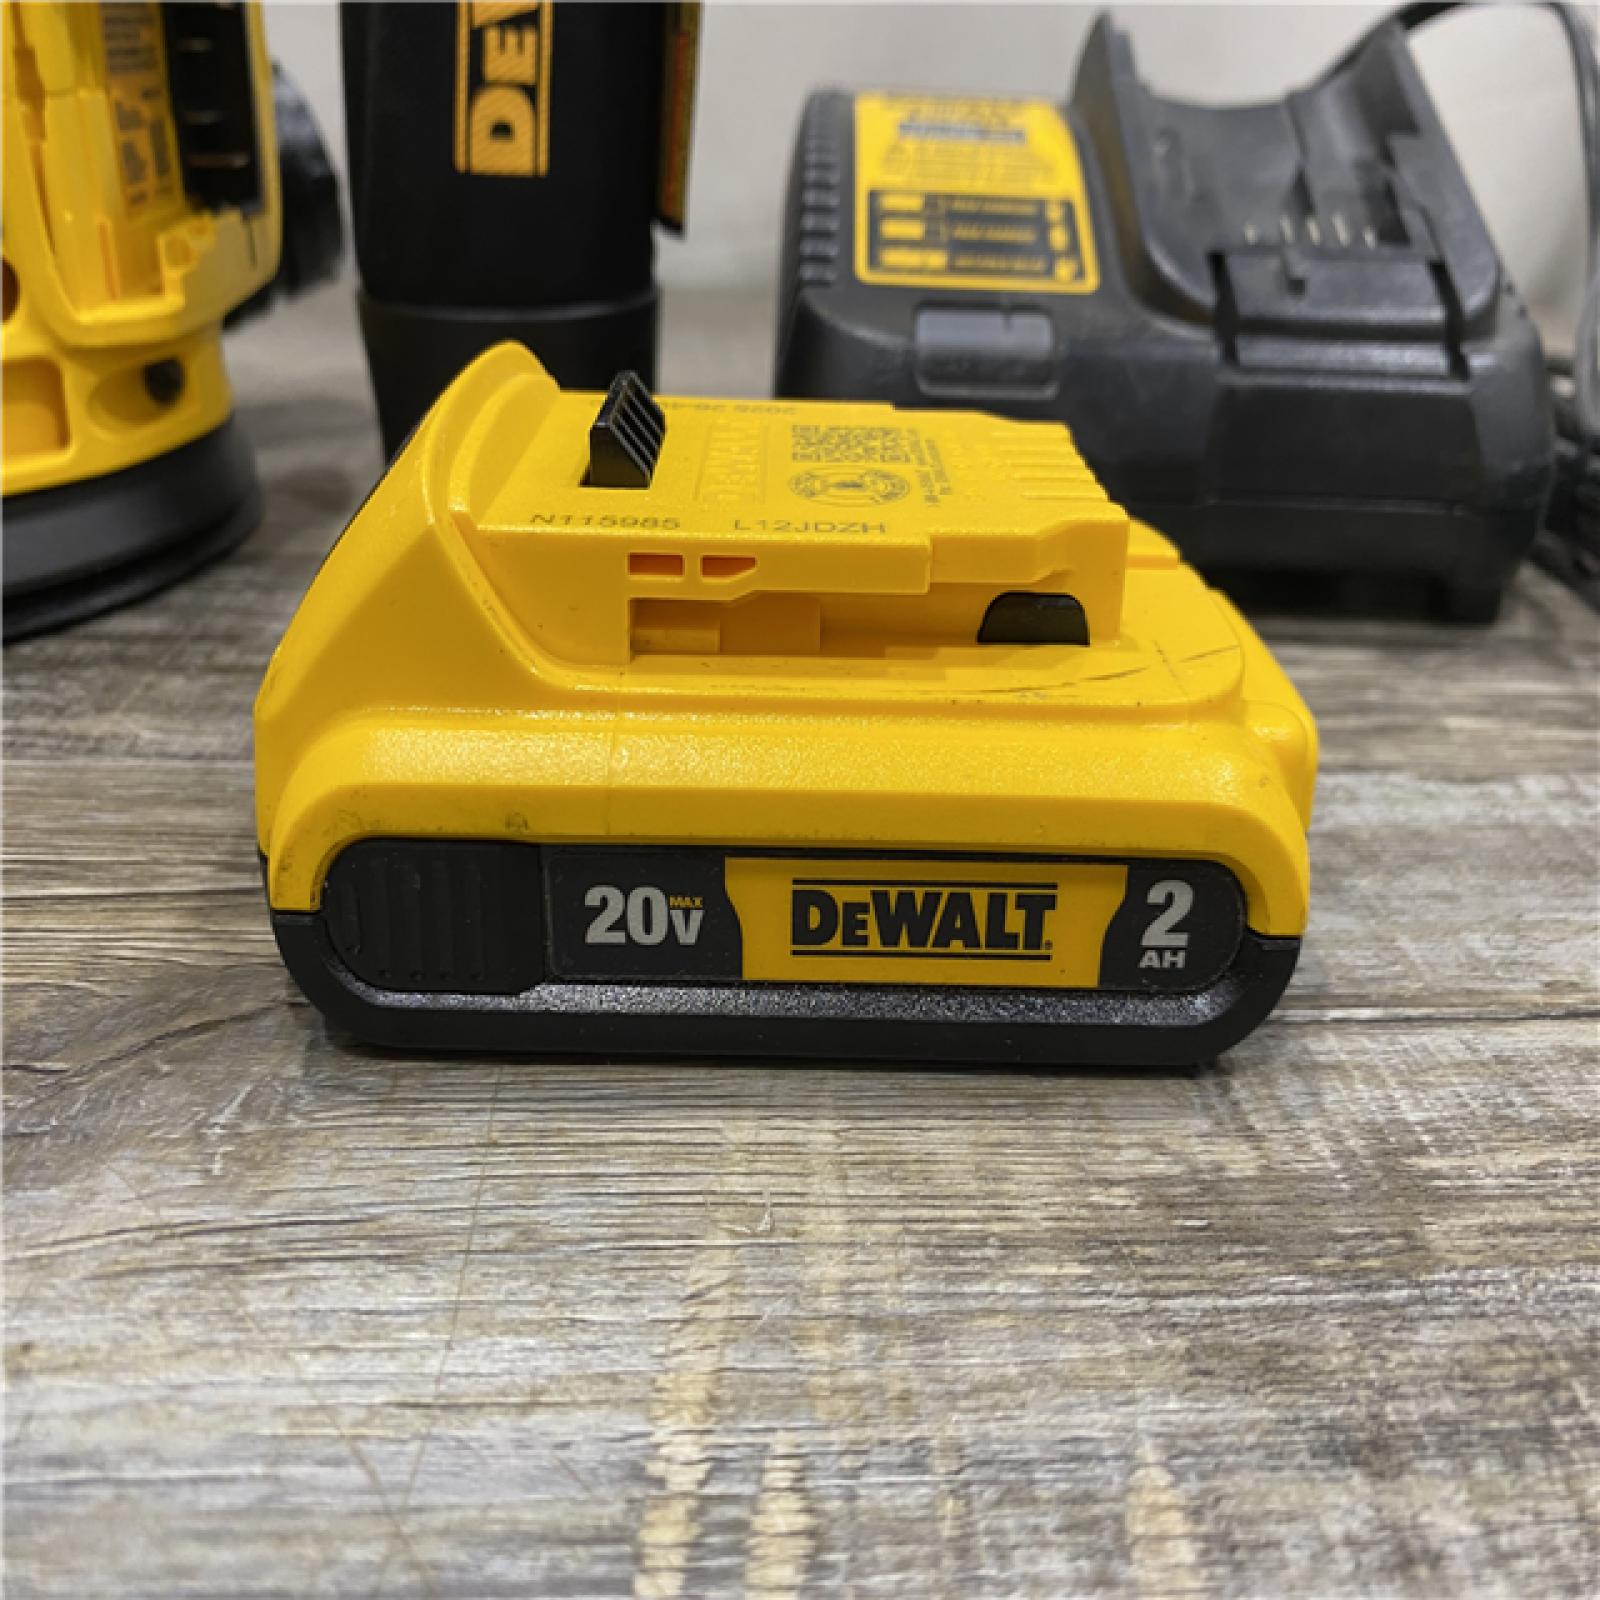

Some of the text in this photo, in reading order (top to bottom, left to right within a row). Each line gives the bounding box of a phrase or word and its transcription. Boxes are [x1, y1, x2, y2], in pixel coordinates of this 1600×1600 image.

[733, 519, 886, 534] L12JDZH
[1140, 879, 1194, 947] 2
[1138, 949, 1186, 969] AH
